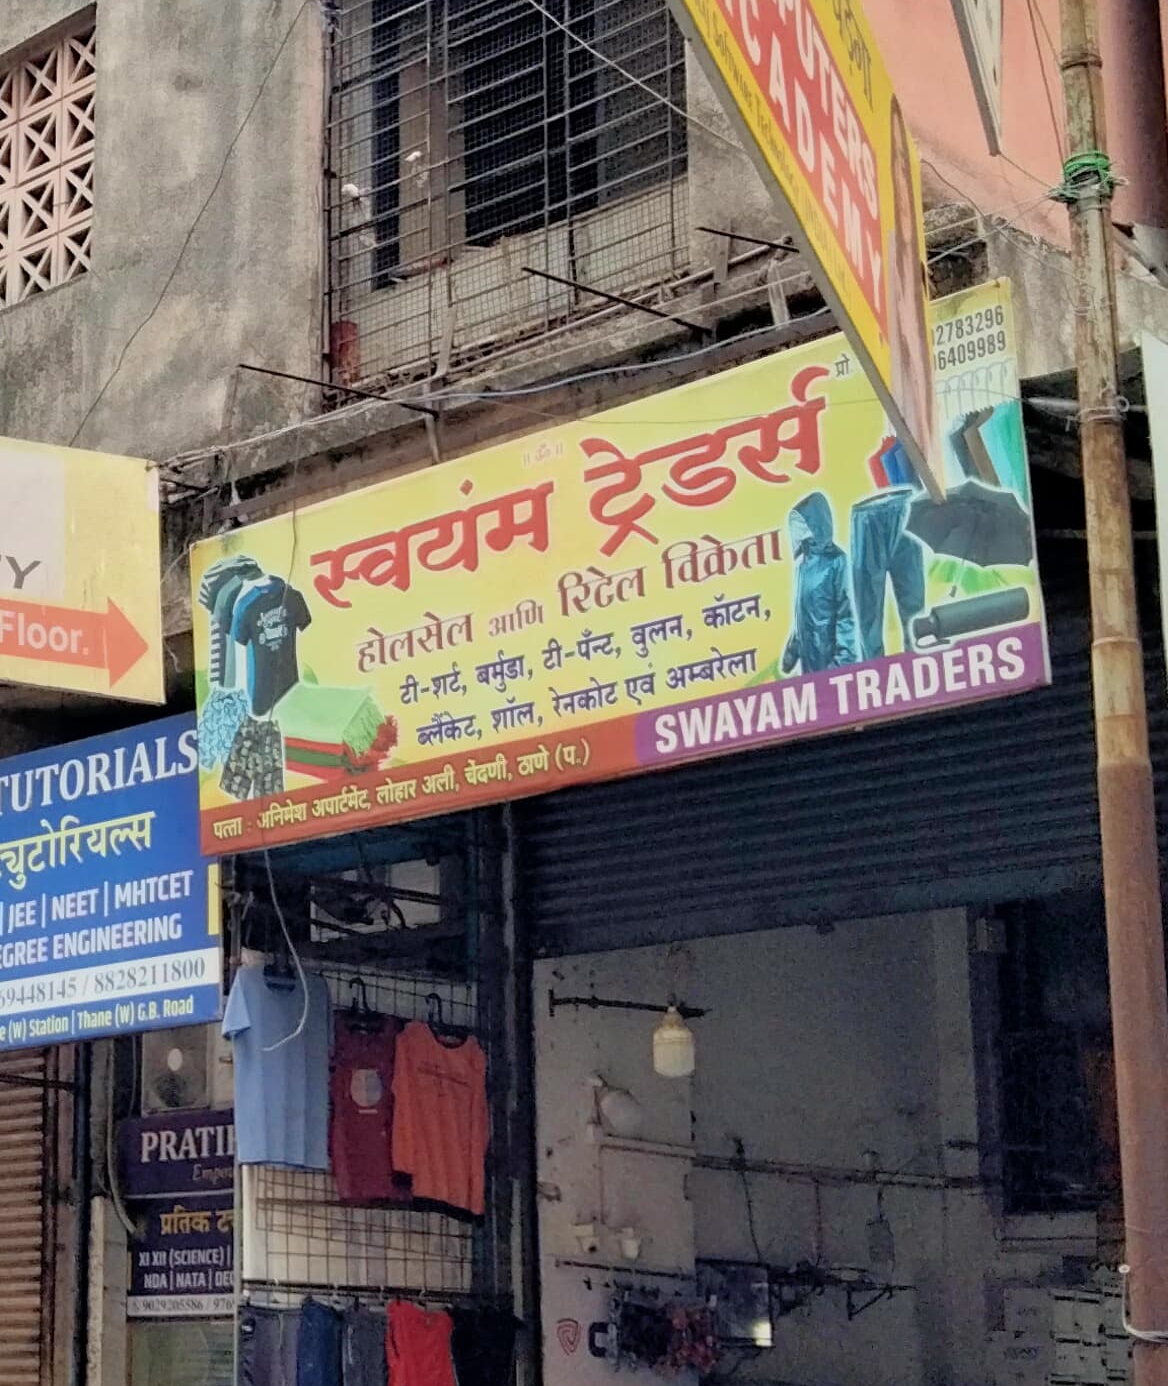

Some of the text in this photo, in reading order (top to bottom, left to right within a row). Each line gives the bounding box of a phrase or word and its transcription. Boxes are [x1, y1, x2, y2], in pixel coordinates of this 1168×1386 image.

[933, 305, 1004, 346] 2783296
[934, 330, 1007, 371] 6409989
[310, 365, 833, 609] स्वयंम ट्रेडर्स
[356, 529, 781, 673] होलसेल आणि रिटेल विक्रेता
[399, 660, 468, 705] टी-शर्ट,
[491, 696, 544, 734] शॉल,
[551, 679, 619, 716] रेनकोट
[625, 663, 655, 704] एवं
[665, 646, 758, 690] अम्बरेला
[654, 636, 1027, 755] SWAYAM TRADERS
[376, 782, 417, 809] लोहार
[516, 744, 549, 774] ठाणे
[8, 899, 37, 929] JEE
[51, 888, 99, 924] NEET
[114, 869, 194, 910] MHTCET
[53, 913, 183, 959] ENGINEERING
[94, 956, 206, 994] 8828211800
[8, 1019, 27, 1042] (W)
[29, 1013, 69, 1037] Station
[78, 1006, 112, 1029] Thane
[114, 1000, 135, 1023] (W)
[162, 994, 194, 1018] Road
[160, 1204, 210, 1236] प्रतिक
[139, 1245, 225, 1268] XI XII (SCIENCE)
[144, 1271, 206, 1289] NDA NATA
